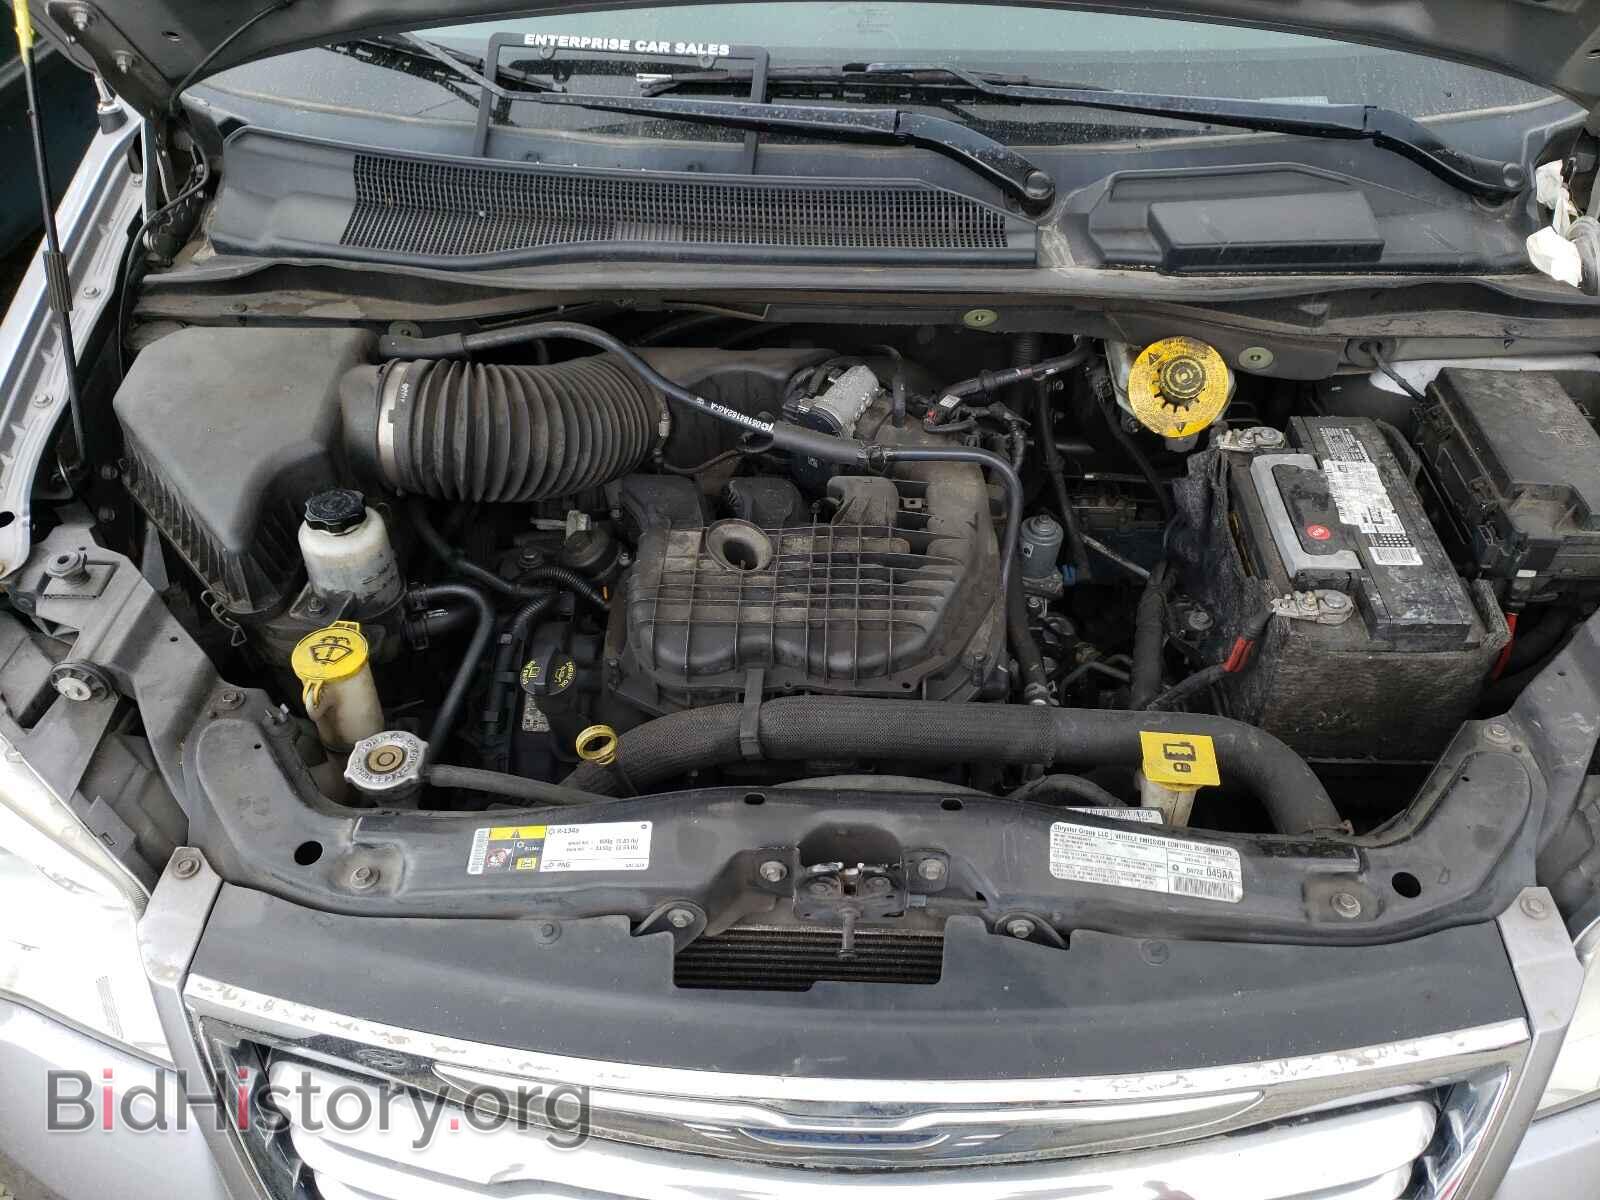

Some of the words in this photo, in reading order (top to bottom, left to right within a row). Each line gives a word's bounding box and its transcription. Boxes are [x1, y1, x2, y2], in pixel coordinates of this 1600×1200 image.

[524, 33, 630, 51] ENTERPRISE
[635, 40, 670, 53] CAR
[674, 42, 730, 56] SALES
